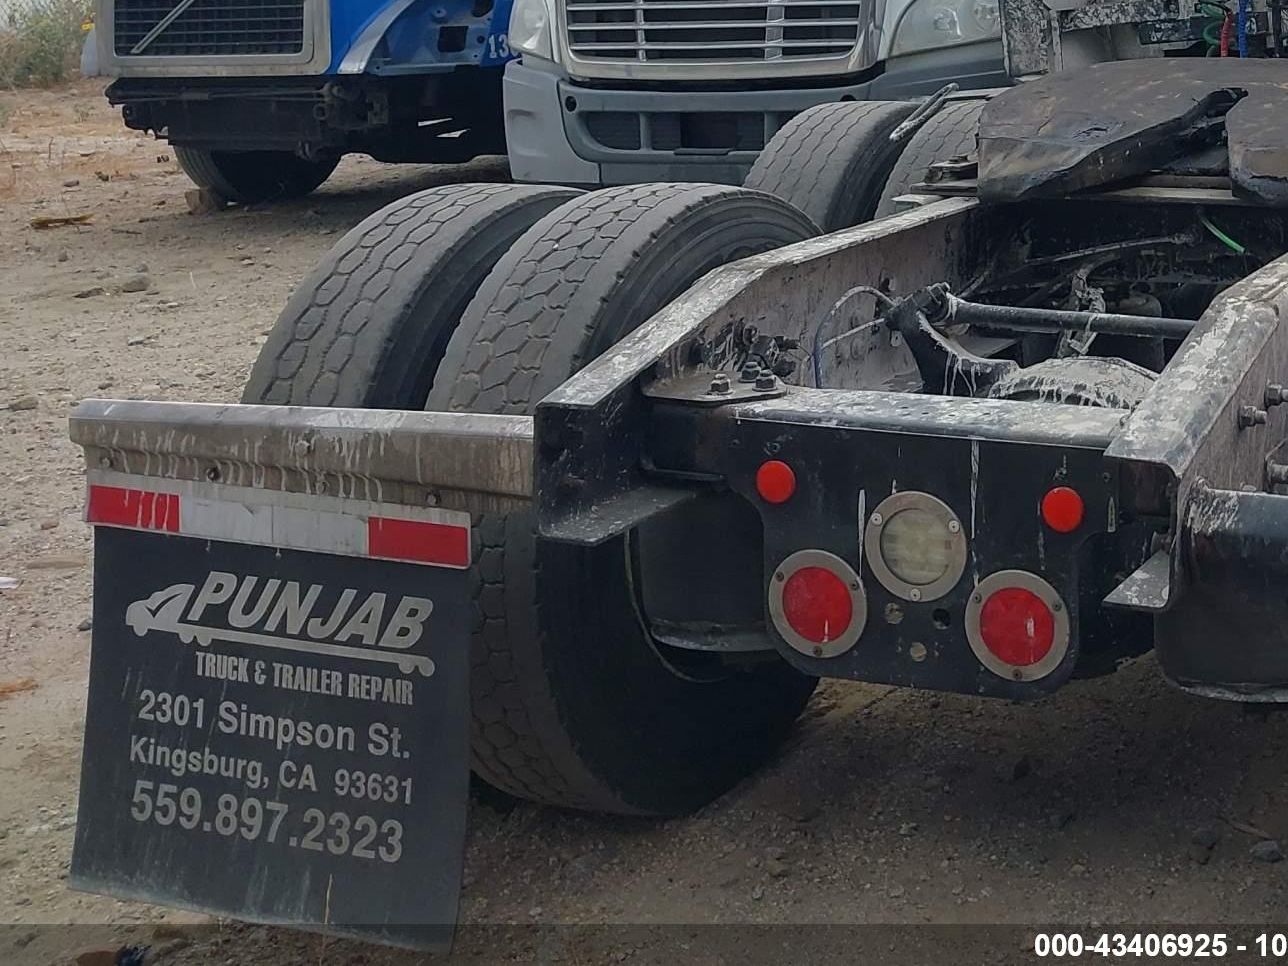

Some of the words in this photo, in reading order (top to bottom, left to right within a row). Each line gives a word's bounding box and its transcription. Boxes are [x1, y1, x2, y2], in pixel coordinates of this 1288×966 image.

[187, 570, 433, 649] PUNJAB
[195, 651, 249, 683] TRUCK
[254, 659, 266, 684] &
[272, 662, 342, 697] TRAILER
[347, 672, 413, 705] REPAIR
[138, 689, 204, 728] 2301
[217, 700, 355, 750] Simpson
[367, 722, 410, 758] St.
[129, 734, 269, 789] Kingsburg,
[279, 760, 318, 792] CA
[334, 768, 412, 804] 93631
[130, 779, 403, 863] 559.897.2323
